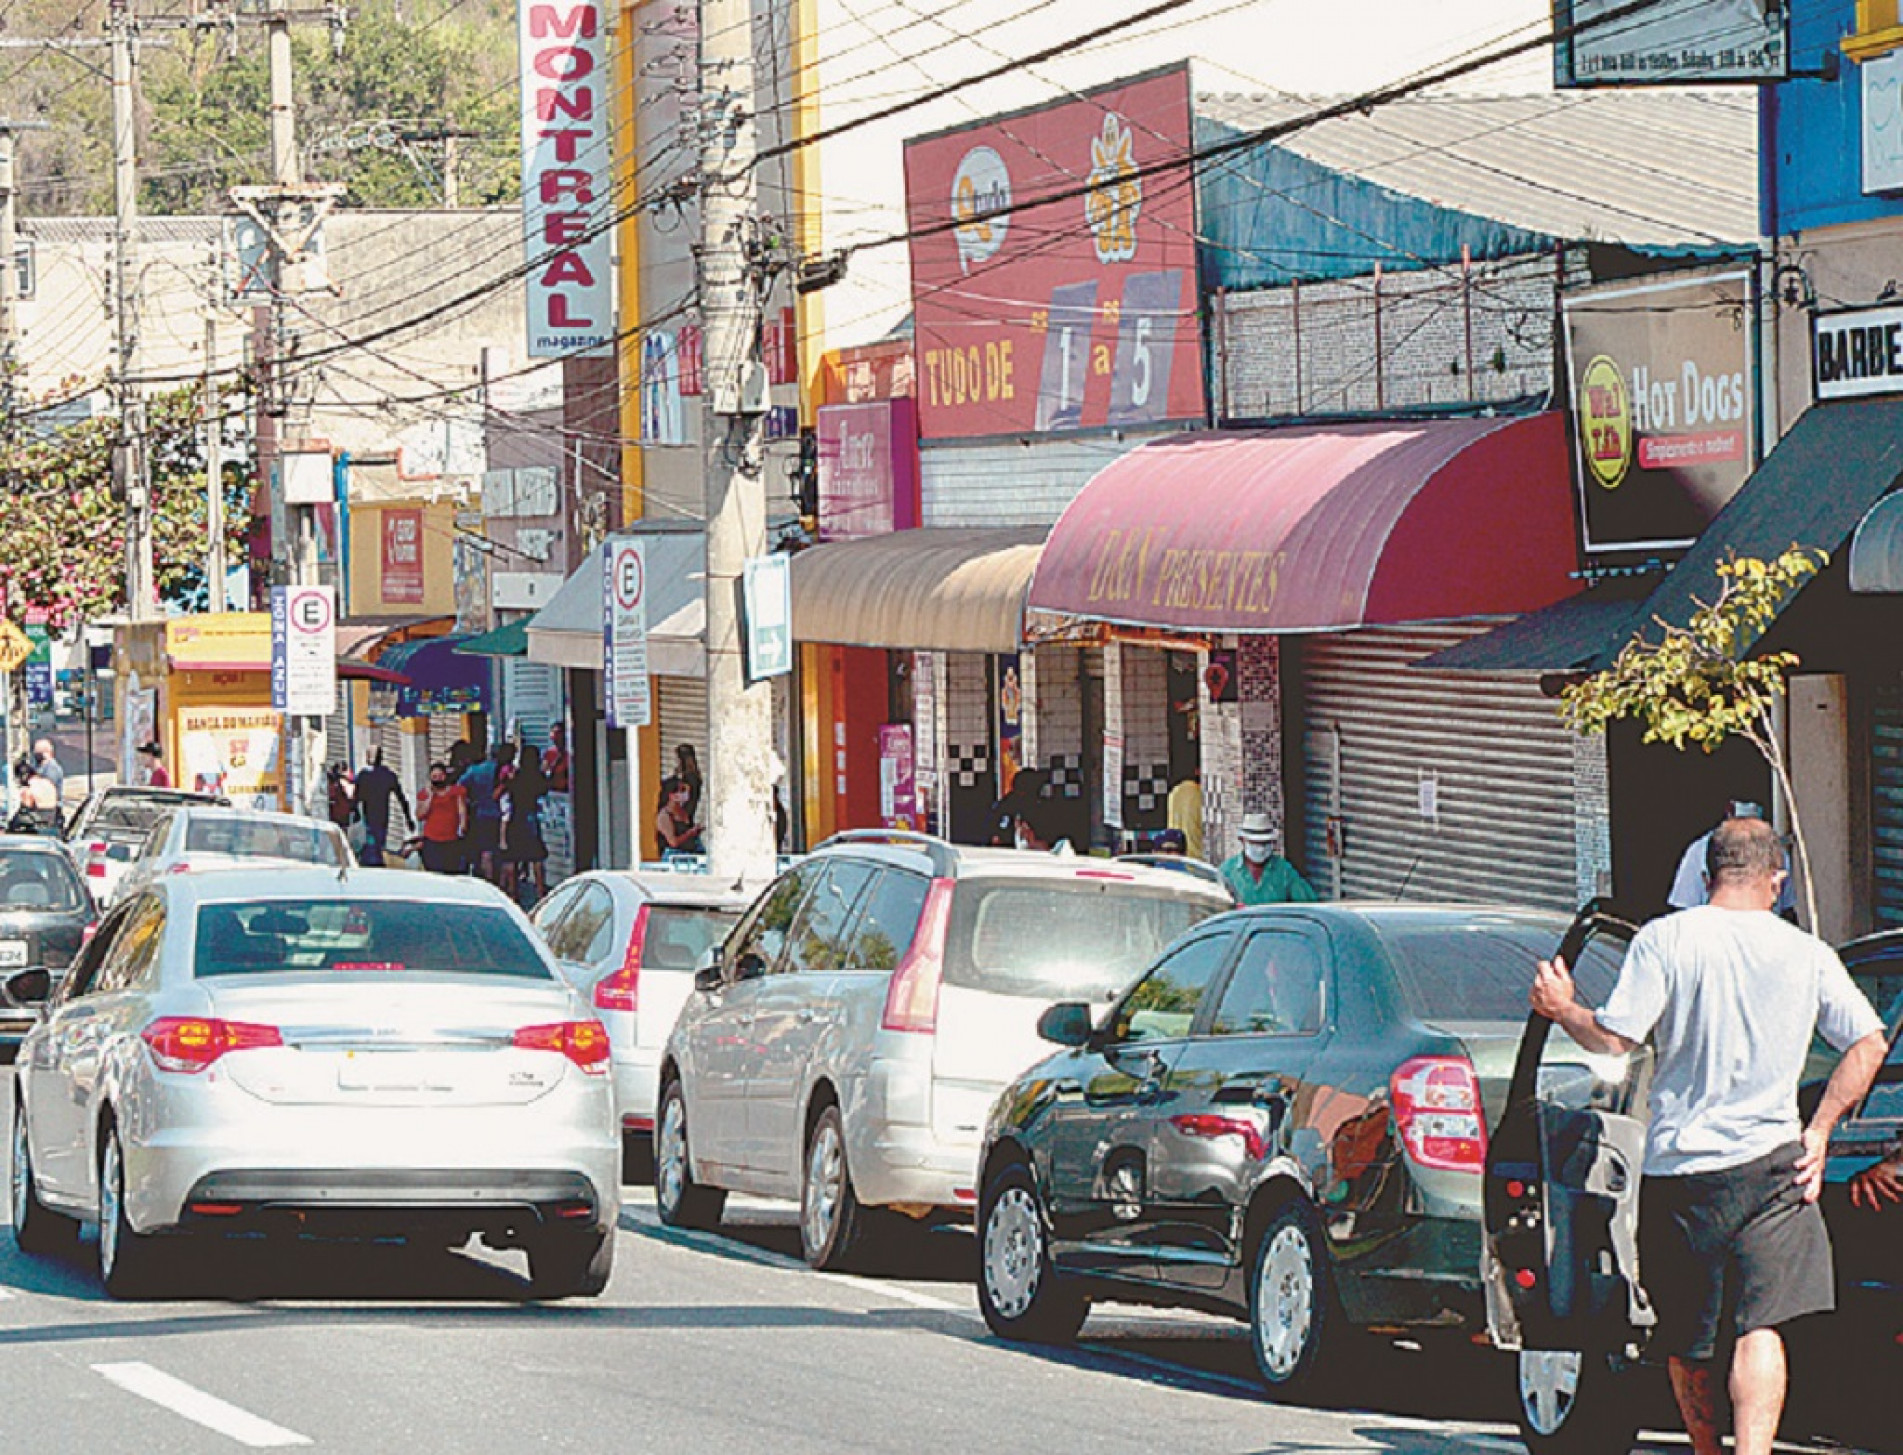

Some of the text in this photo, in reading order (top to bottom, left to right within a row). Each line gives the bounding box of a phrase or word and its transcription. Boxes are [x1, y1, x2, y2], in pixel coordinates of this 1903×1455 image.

[529, 5, 597, 328] MONTREAL
[926, 345, 980, 406] TUDO
[986, 339, 1014, 401] DE
[1059, 326, 1072, 411] 1
[1093, 345, 1111, 375] a
[1131, 318, 1151, 406] 5
[1818, 323, 1903, 381] BARBE
[623, 562, 635, 595] E
[304, 600, 320, 625] E
